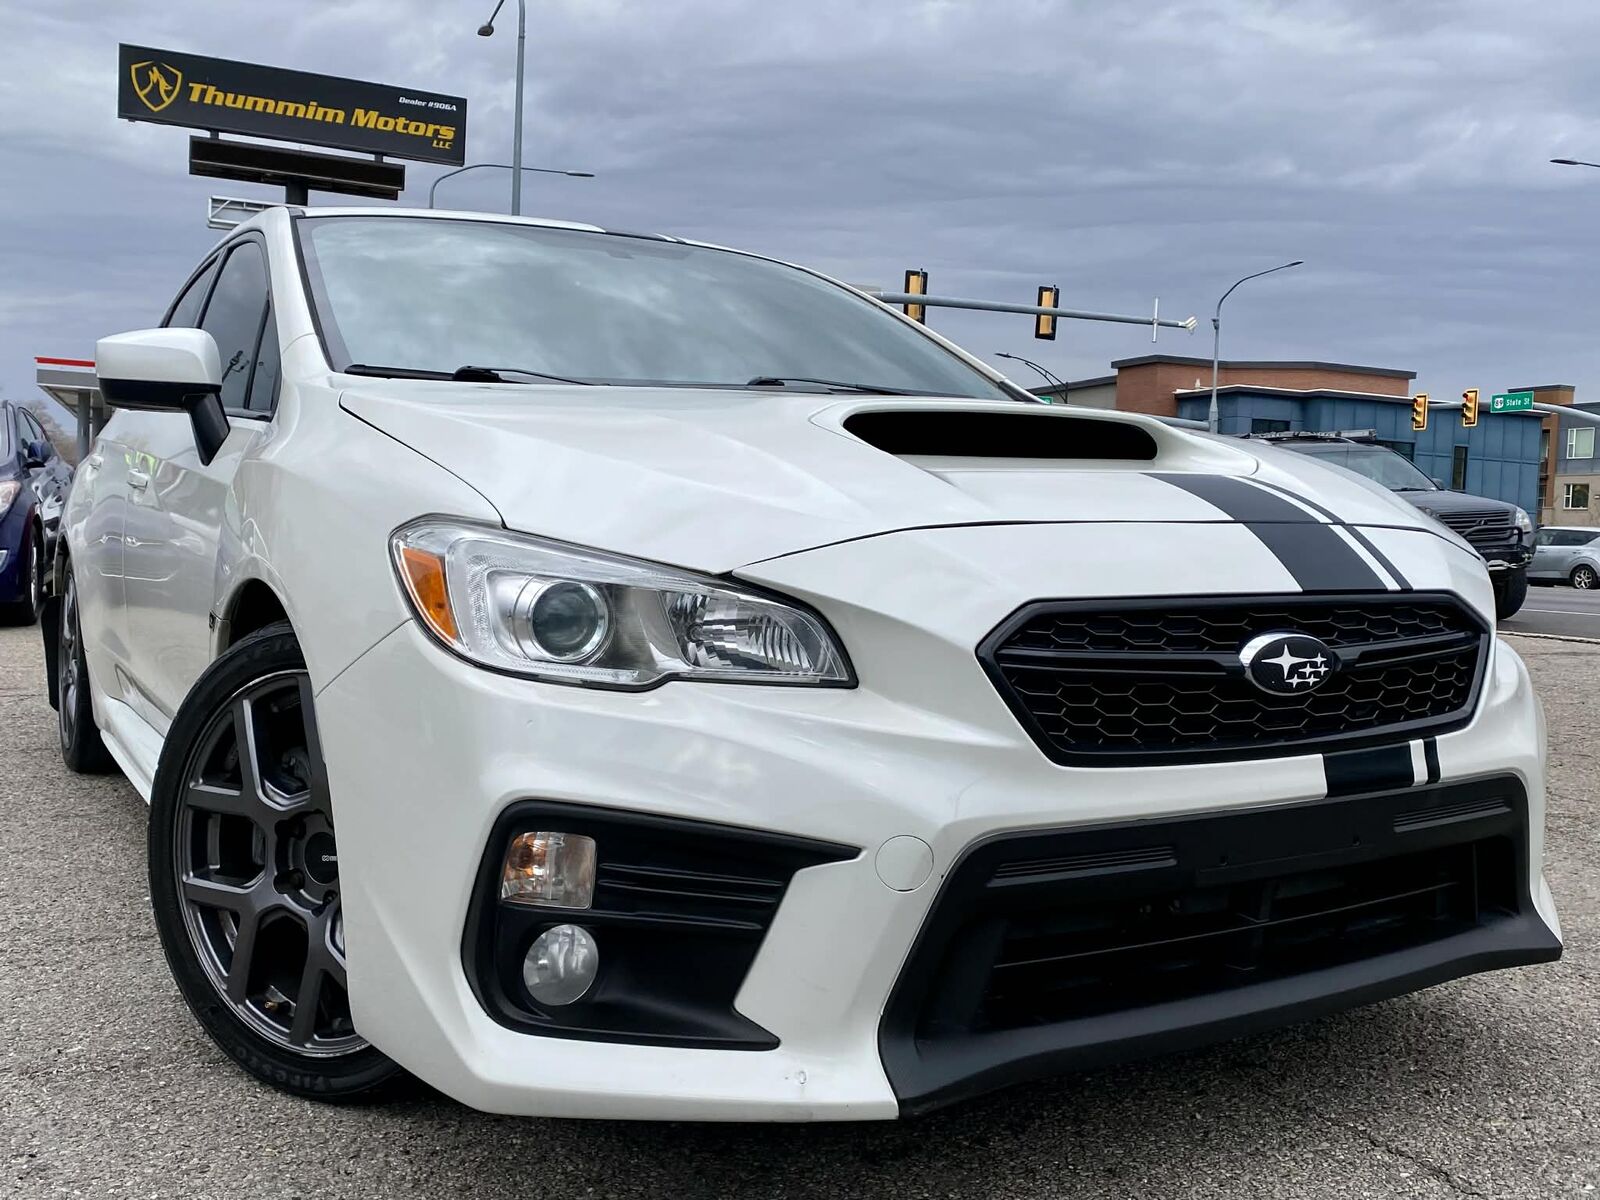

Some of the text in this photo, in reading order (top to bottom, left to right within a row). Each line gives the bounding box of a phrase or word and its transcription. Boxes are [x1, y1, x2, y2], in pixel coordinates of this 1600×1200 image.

[398, 96, 427, 107] Dealer
[188, 82, 456, 140] Thummim Motors
[432, 140, 453, 150] LLC
[1523, 397, 1530, 405] St
